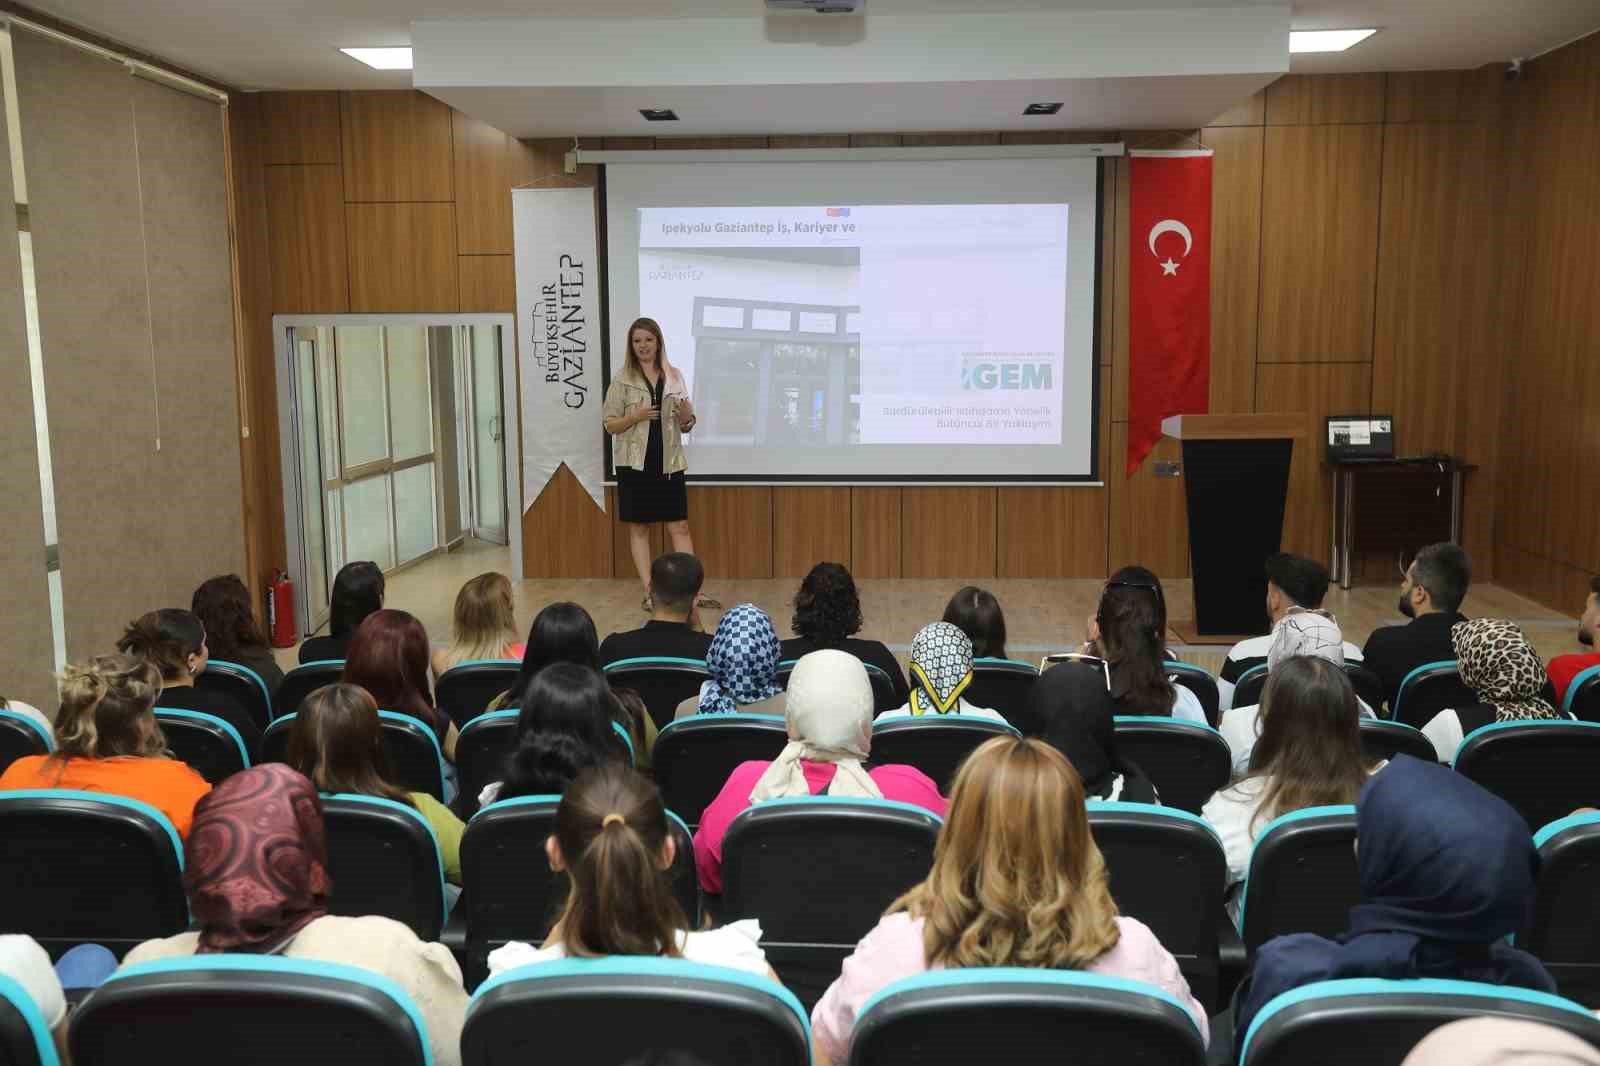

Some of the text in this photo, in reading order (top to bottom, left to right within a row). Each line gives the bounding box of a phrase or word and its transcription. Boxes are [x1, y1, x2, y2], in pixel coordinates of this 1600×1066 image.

[714, 222, 774, 236] Gaziantep
[794, 222, 838, 235] Kariyer
[840, 224, 856, 234] ve
